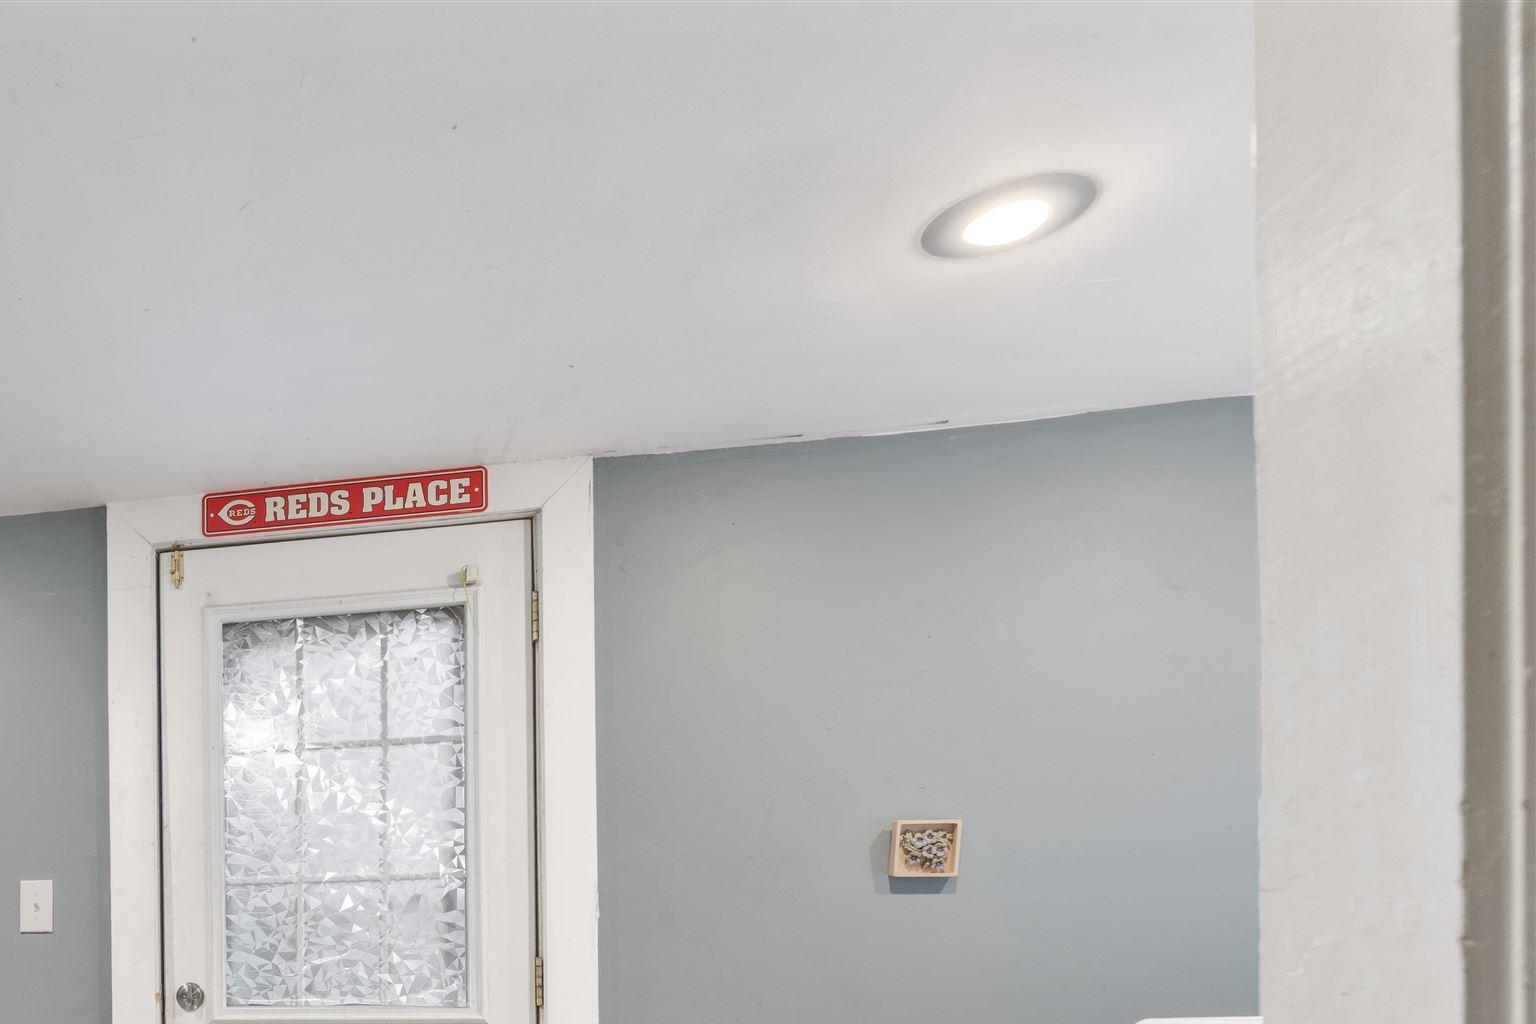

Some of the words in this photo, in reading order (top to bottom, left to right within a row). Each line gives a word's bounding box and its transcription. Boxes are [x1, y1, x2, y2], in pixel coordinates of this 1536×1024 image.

[228, 507, 256, 518] REDS
[264, 489, 351, 522] REDS
[362, 477, 471, 513] PLACE
